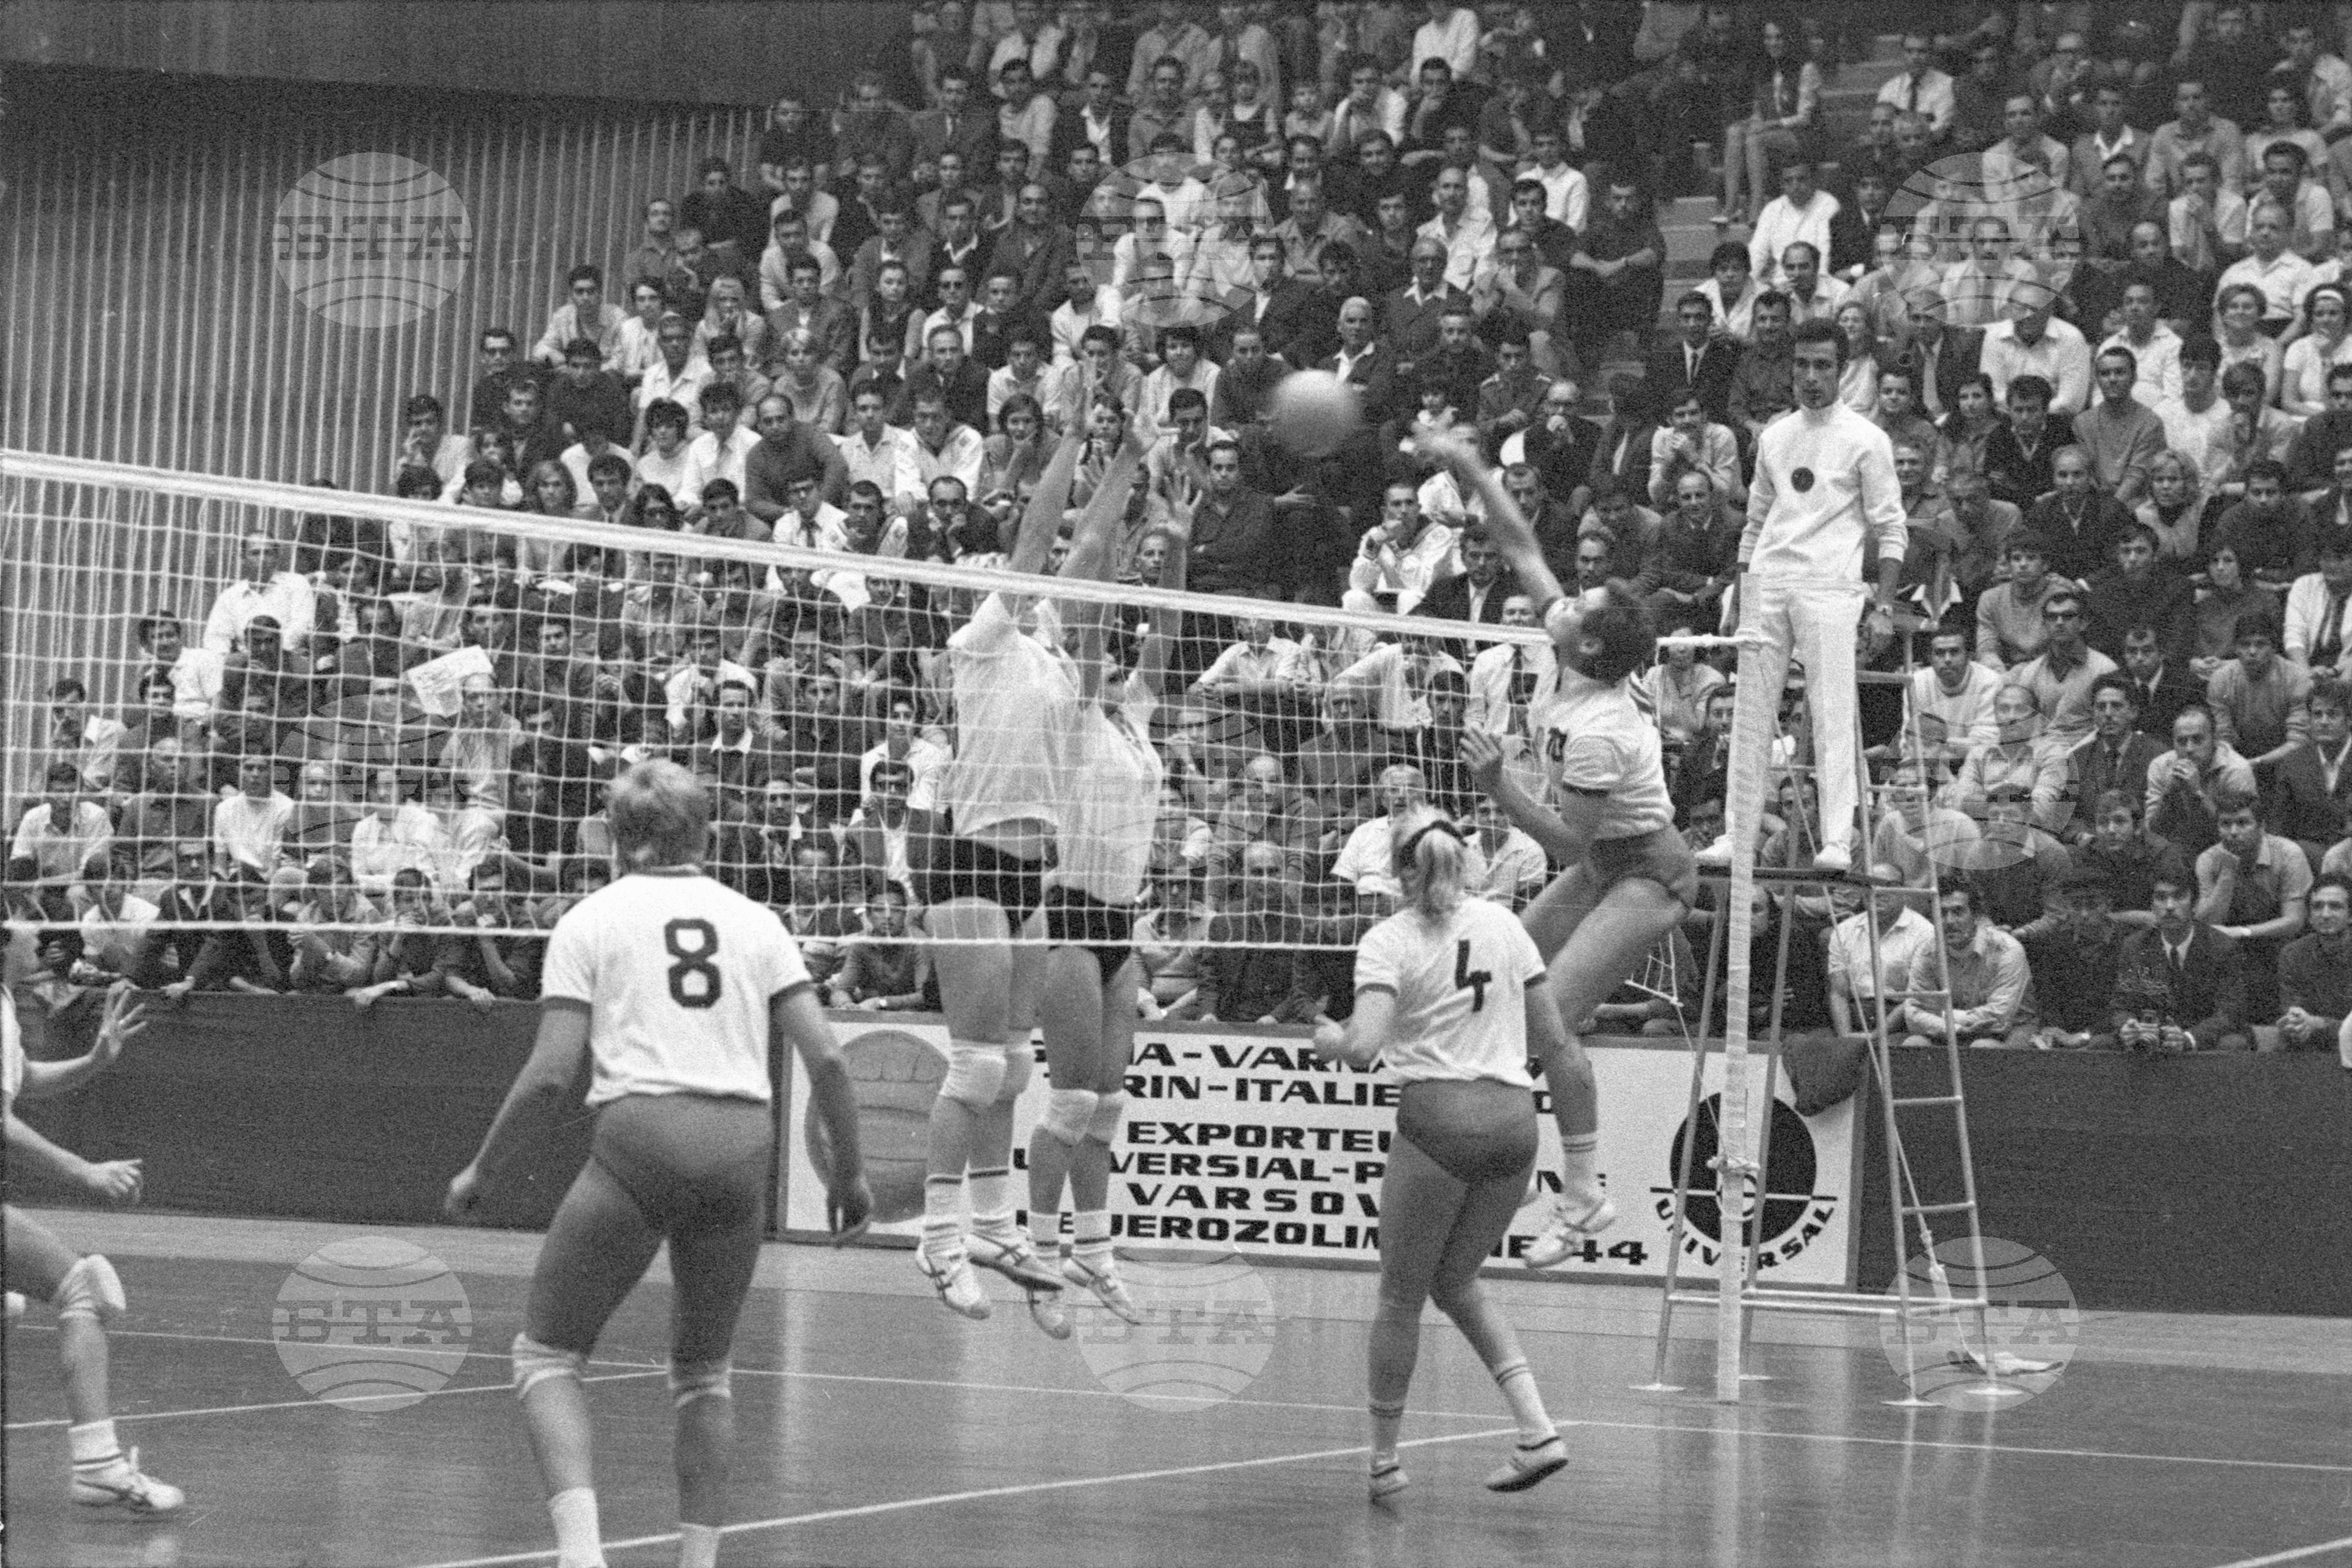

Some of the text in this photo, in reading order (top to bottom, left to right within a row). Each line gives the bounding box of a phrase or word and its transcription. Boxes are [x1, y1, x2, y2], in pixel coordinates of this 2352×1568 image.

[664, 918, 721, 1008] 8
[1455, 940, 1491, 1012] 4
[1656, 1198, 1834, 1273] UIVRSAL
